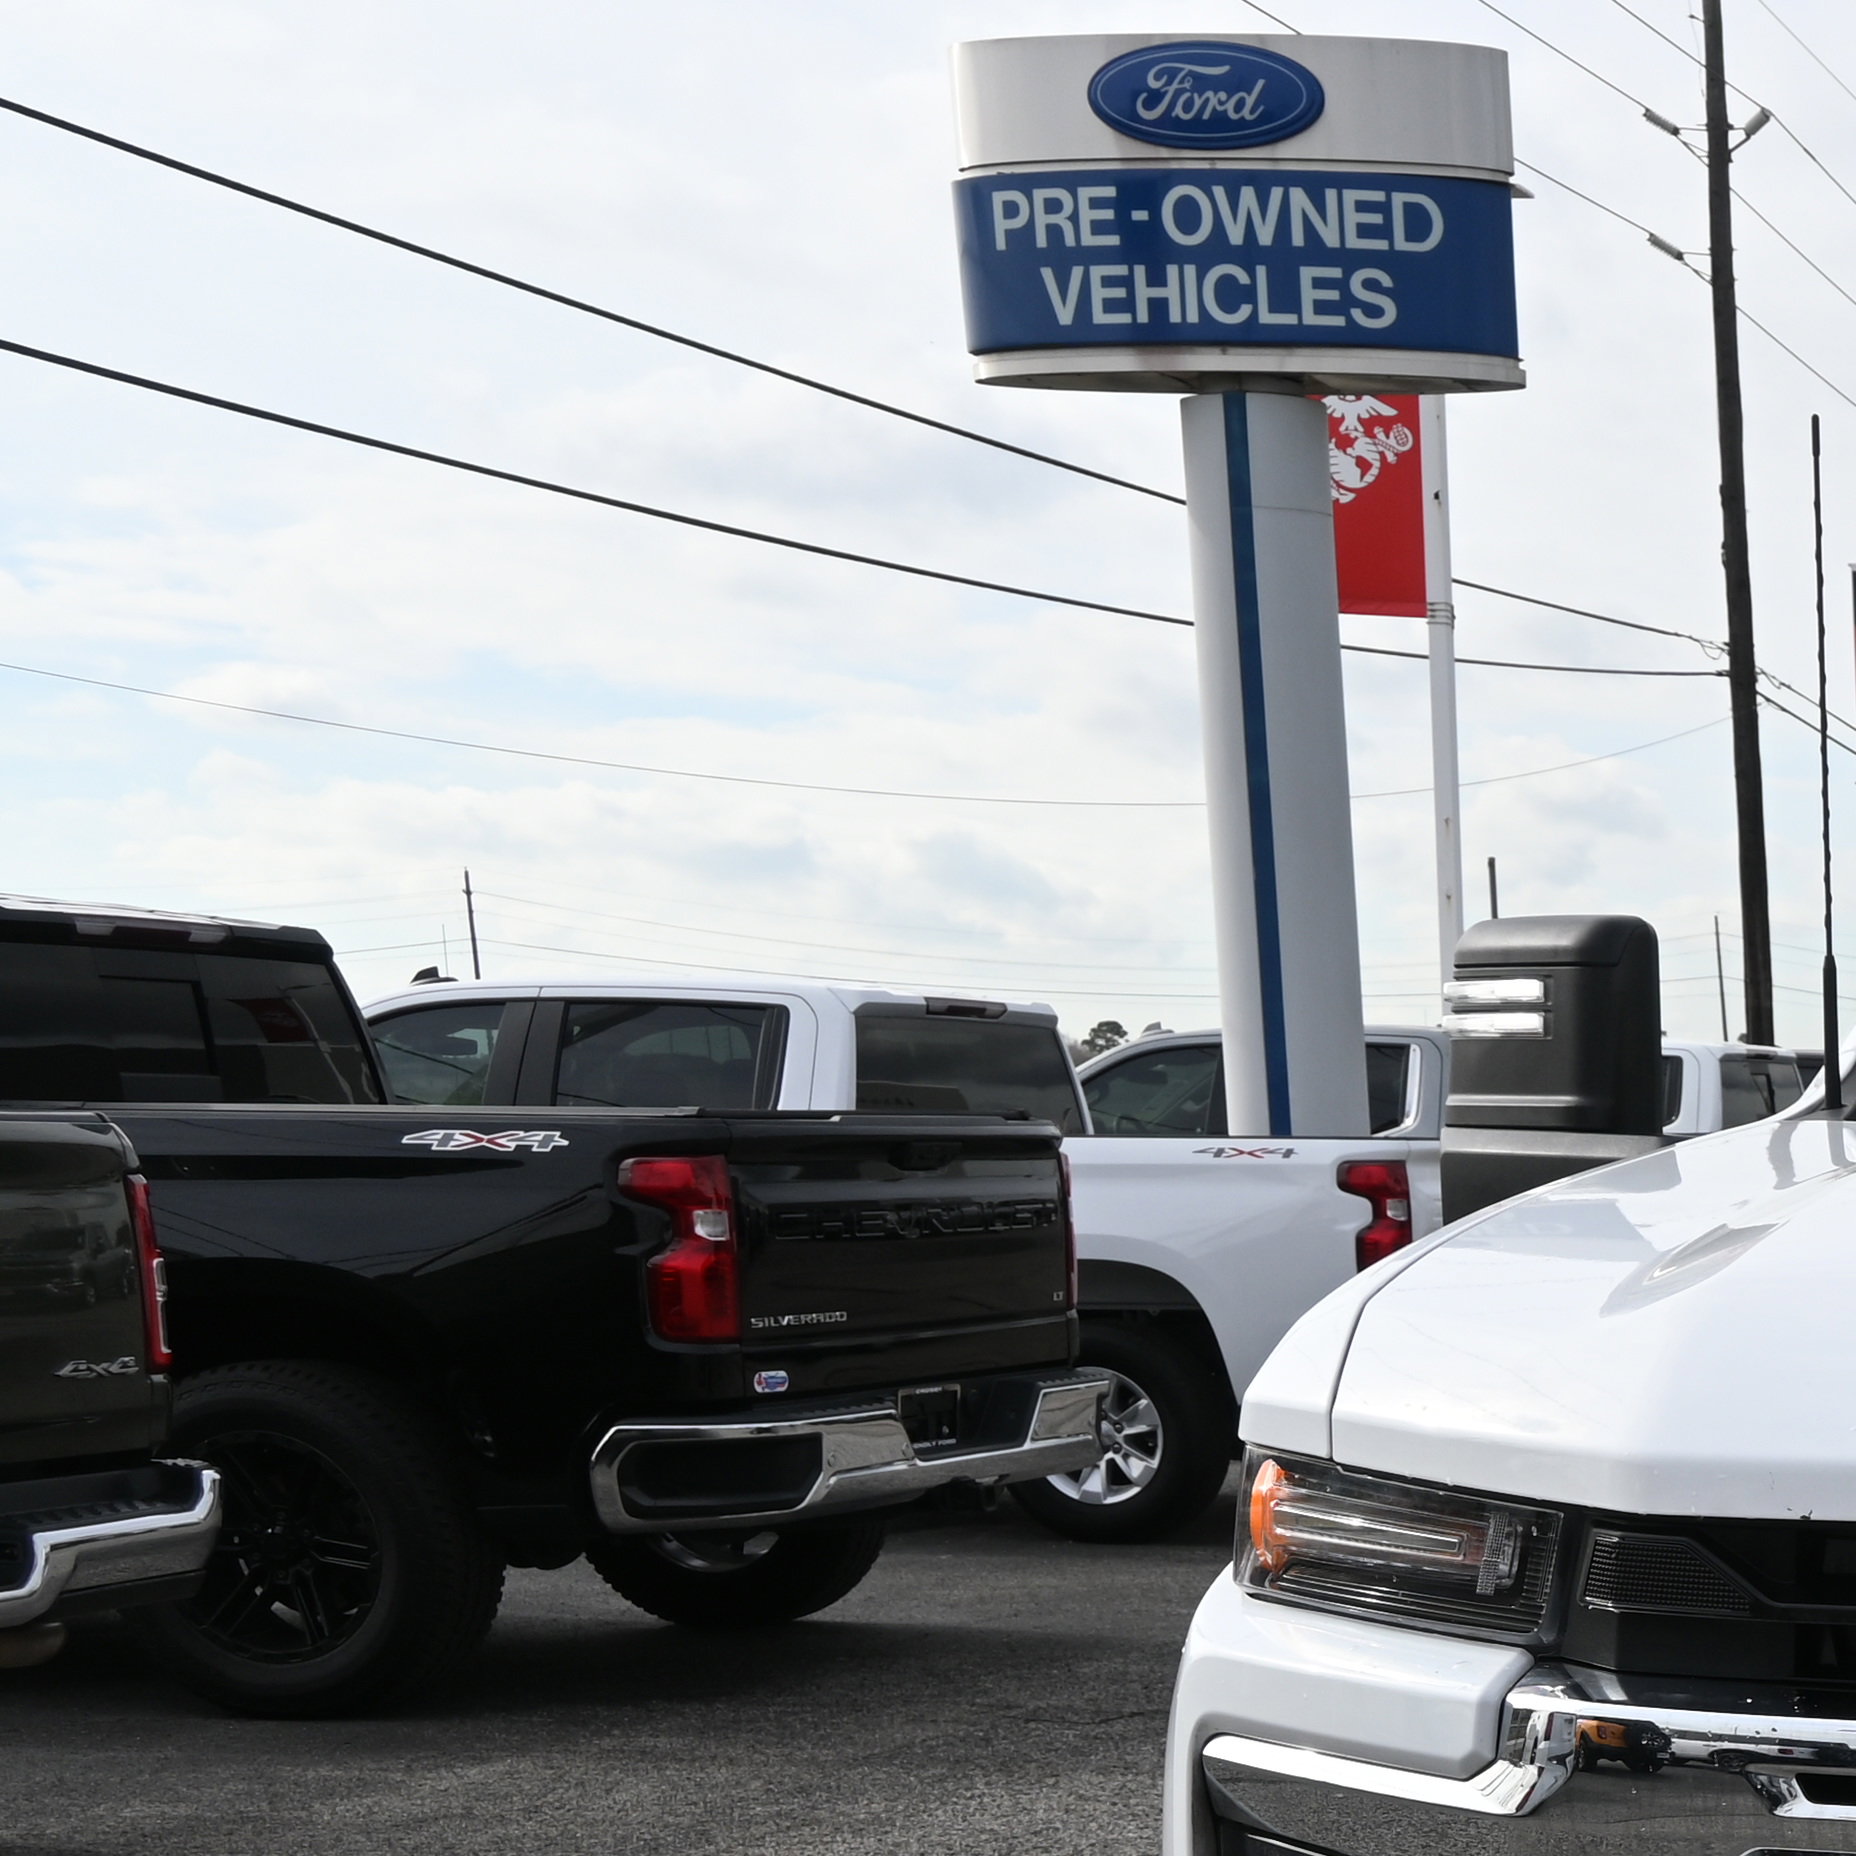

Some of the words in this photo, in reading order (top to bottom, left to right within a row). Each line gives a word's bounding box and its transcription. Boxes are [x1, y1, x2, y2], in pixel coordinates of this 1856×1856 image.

[1135, 62, 1266, 122] Ford
[990, 183, 1445, 254] PRE-OWNED
[1039, 263, 1398, 330] VEHICLES
[750, 1310, 848, 1329] SILVERADO
